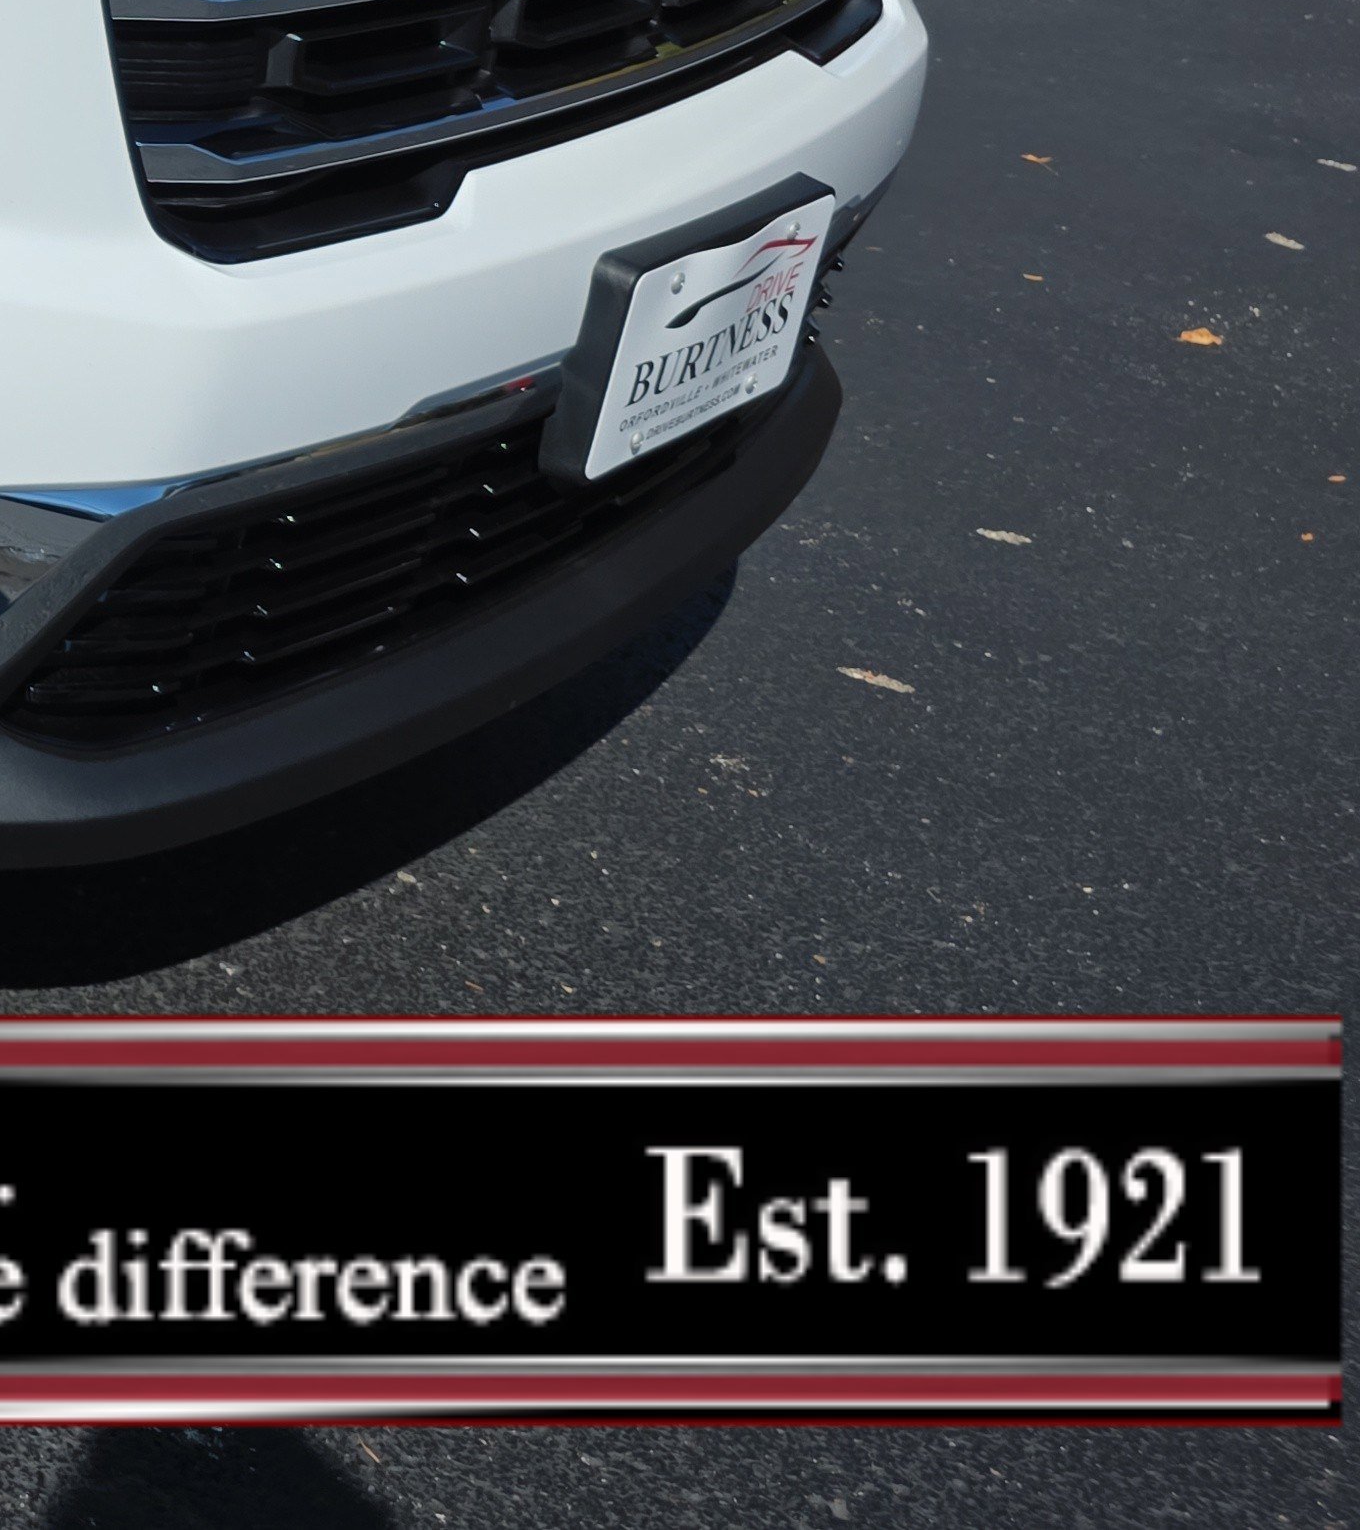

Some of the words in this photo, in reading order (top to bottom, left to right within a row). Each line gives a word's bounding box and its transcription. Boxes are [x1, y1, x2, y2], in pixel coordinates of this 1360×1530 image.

[746, 261, 804, 313] DRIVE
[618, 383, 701, 432] ORFORDVILLE
[711, 344, 779, 389] WHITEWATER
[624, 290, 795, 408] BURTNESS
